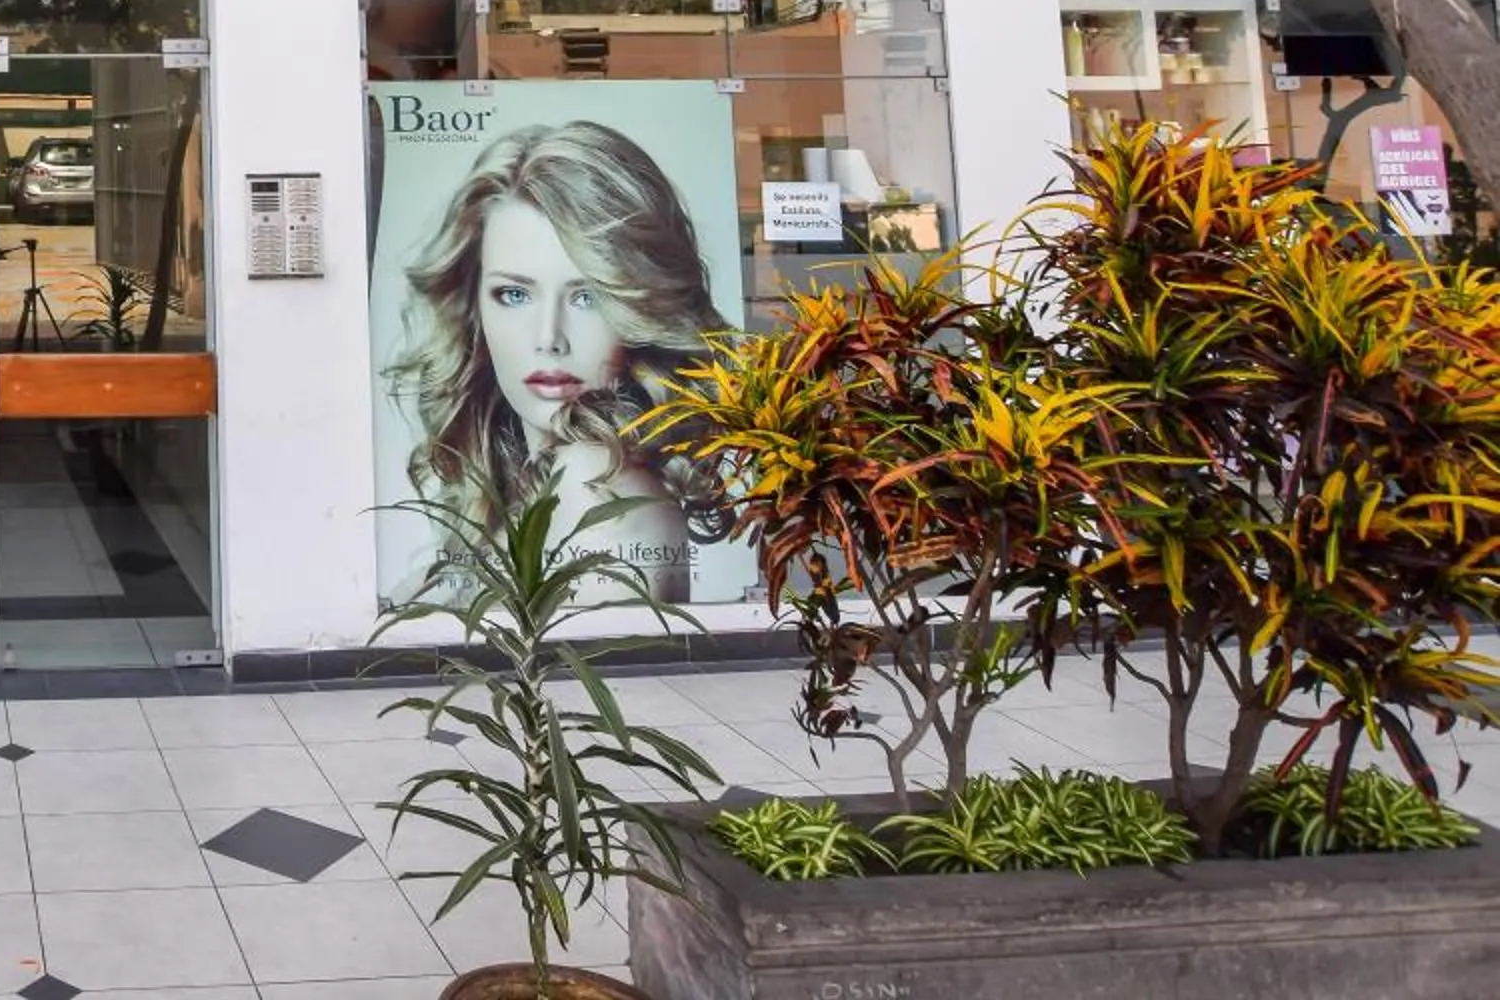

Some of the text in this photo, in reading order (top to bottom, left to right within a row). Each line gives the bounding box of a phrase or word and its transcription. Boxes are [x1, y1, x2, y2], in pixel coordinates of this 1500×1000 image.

[386, 95, 492, 133] Baor
[399, 134, 479, 143] PROFESSIONAL
[619, 542, 700, 564] Lifestyle
